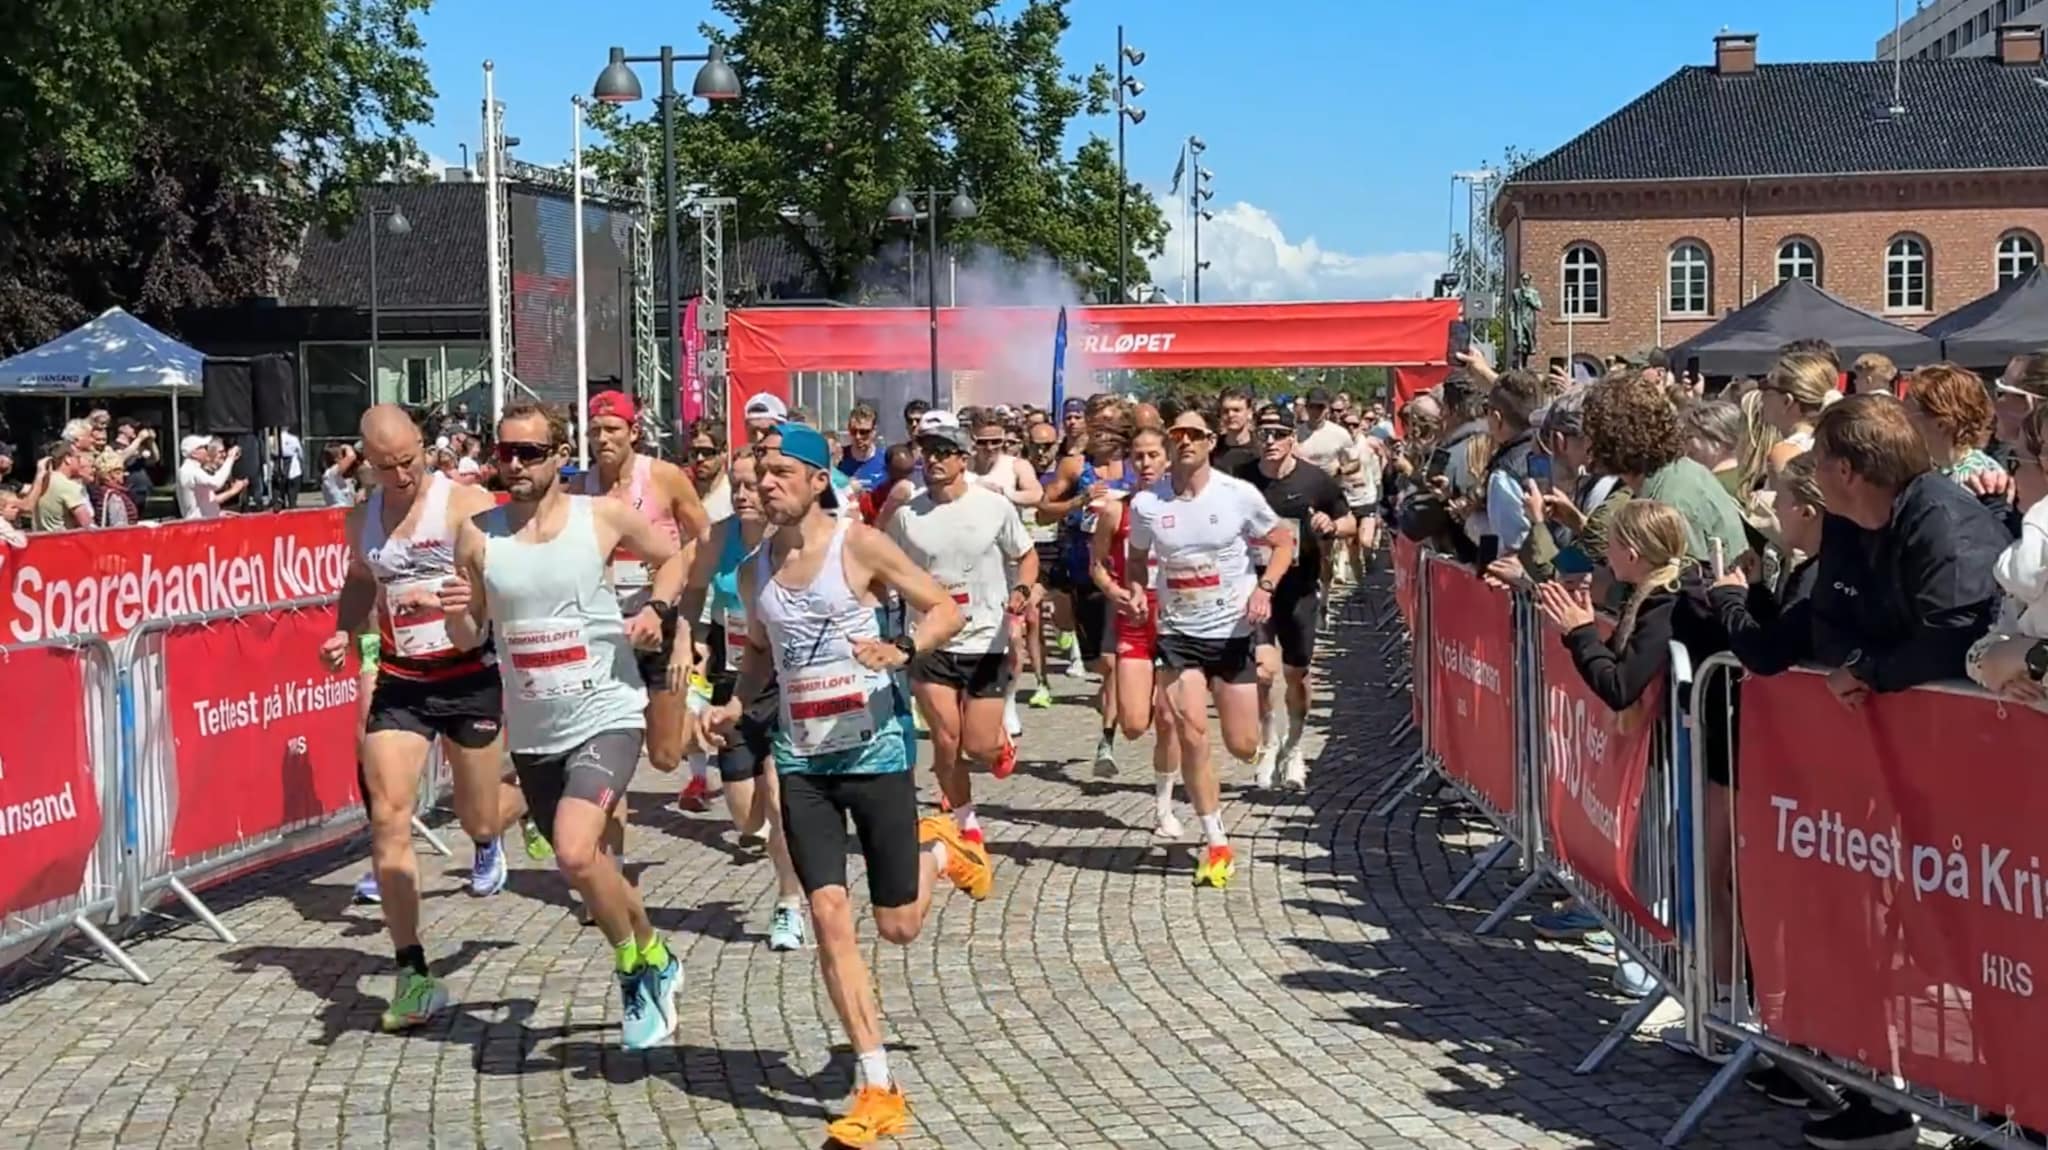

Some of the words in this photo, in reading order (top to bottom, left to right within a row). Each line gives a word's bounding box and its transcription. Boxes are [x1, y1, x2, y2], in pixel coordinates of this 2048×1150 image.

[1082, 333, 1176, 353] RLØPET
[9, 545, 269, 642] Sparebanken
[193, 691, 259, 737] Tettest
[263, 683, 283, 730] på
[1770, 795, 1905, 883] Tettest
[1912, 834, 1970, 903] på
[1981, 843, 2048, 920] Kri
